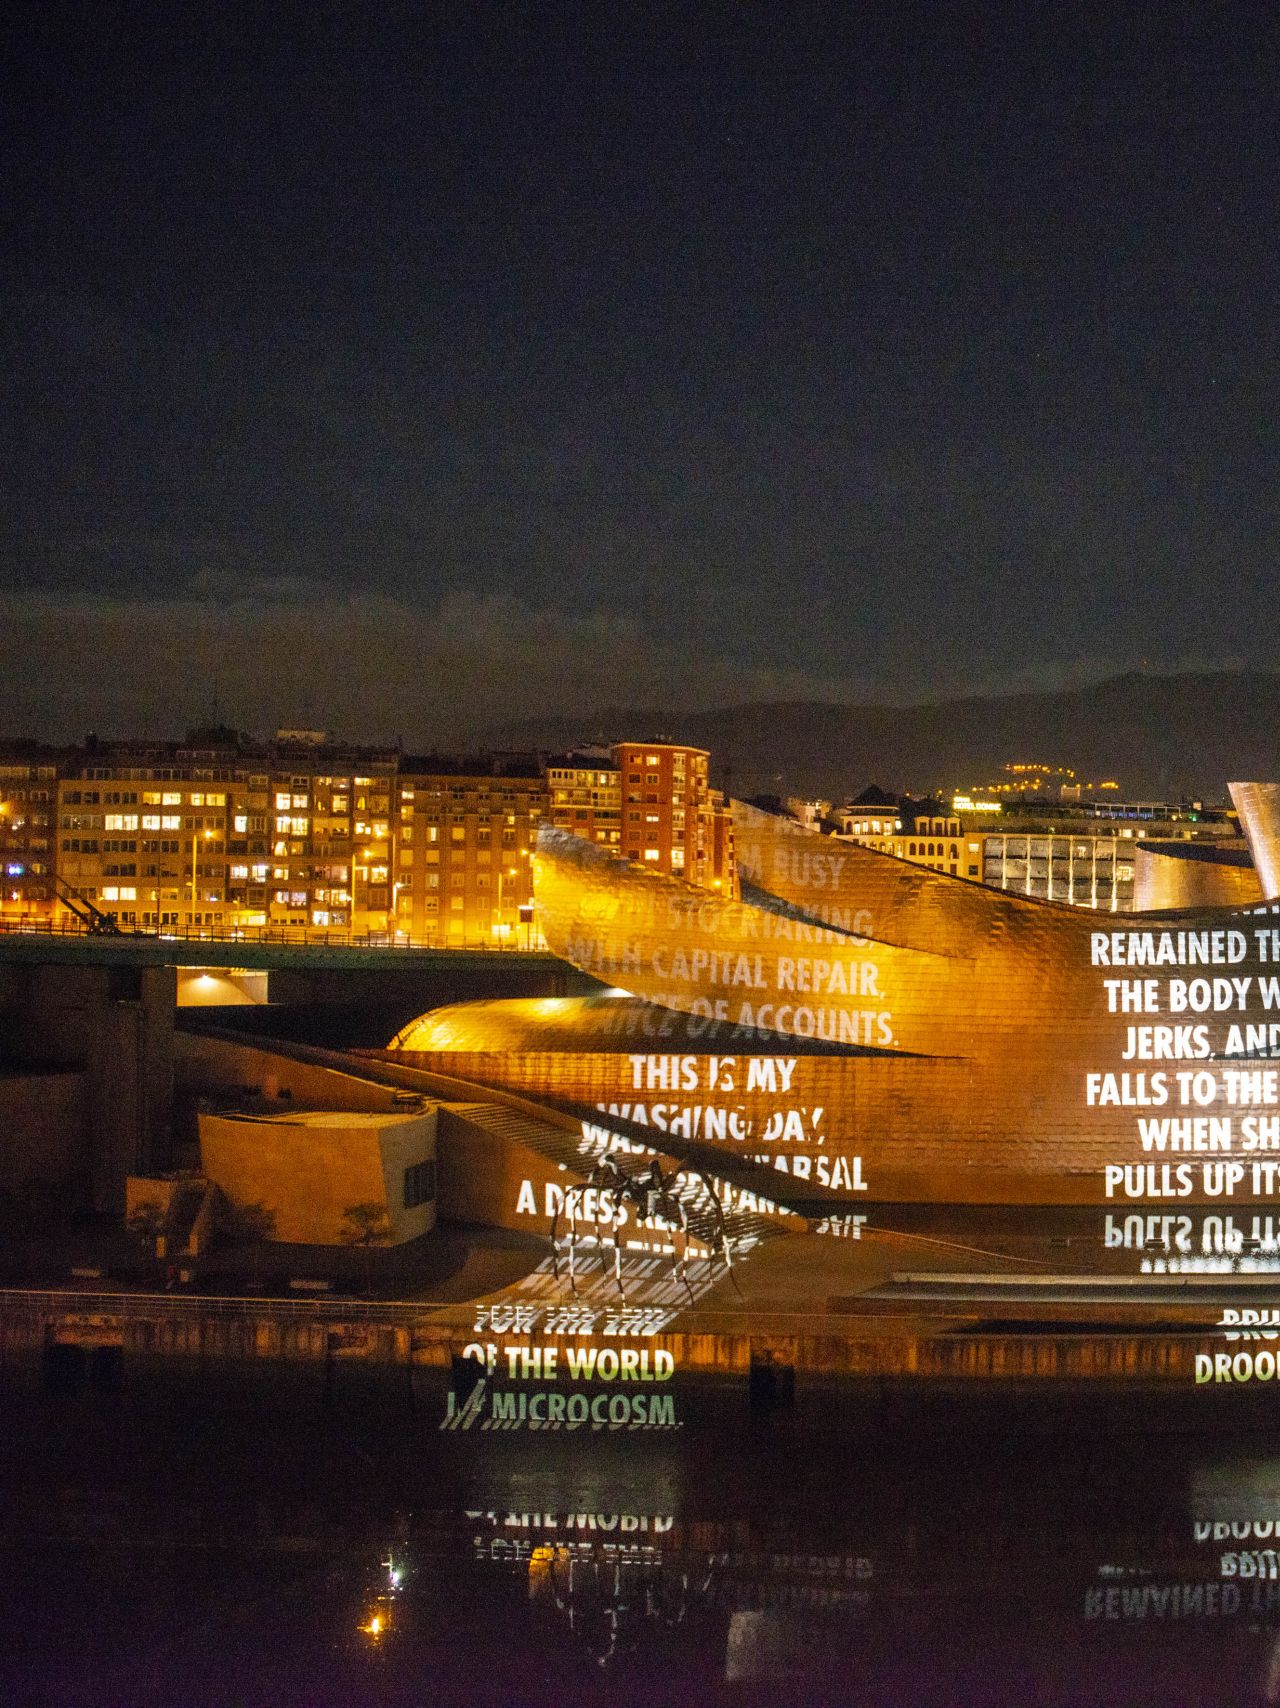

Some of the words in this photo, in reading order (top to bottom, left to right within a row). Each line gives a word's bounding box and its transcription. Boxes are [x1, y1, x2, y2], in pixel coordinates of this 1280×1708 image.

[773, 848, 847, 891] BUSY
[1091, 931, 1247, 966] REMAINED
[651, 943, 769, 990] CAPITAL
[777, 957, 886, 999] REPAIR,
[1103, 979, 1159, 1012] THE
[1169, 977, 1253, 1012] BODY
[735, 1002, 900, 1047] ACCOUNTS.
[1122, 1025, 1216, 1062] JERKS,
[629, 1055, 699, 1090] THIS
[710, 1057, 736, 1092] IS
[747, 1058, 797, 1093] MY
[1086, 1072, 1168, 1106] FALLS
[1176, 1072, 1216, 1106] TO
[1222, 1070, 1278, 1105] THE
[1138, 1117, 1231, 1151] WHEN
[516, 1179, 537, 1215] A
[1105, 1164, 1193, 1197] PULLS
[1203, 1163, 1244, 1196] UP
[504, 1346, 558, 1380] THE
[566, 1347, 675, 1381] WORLD
[492, 1391, 685, 1426] MICROCOSM.
